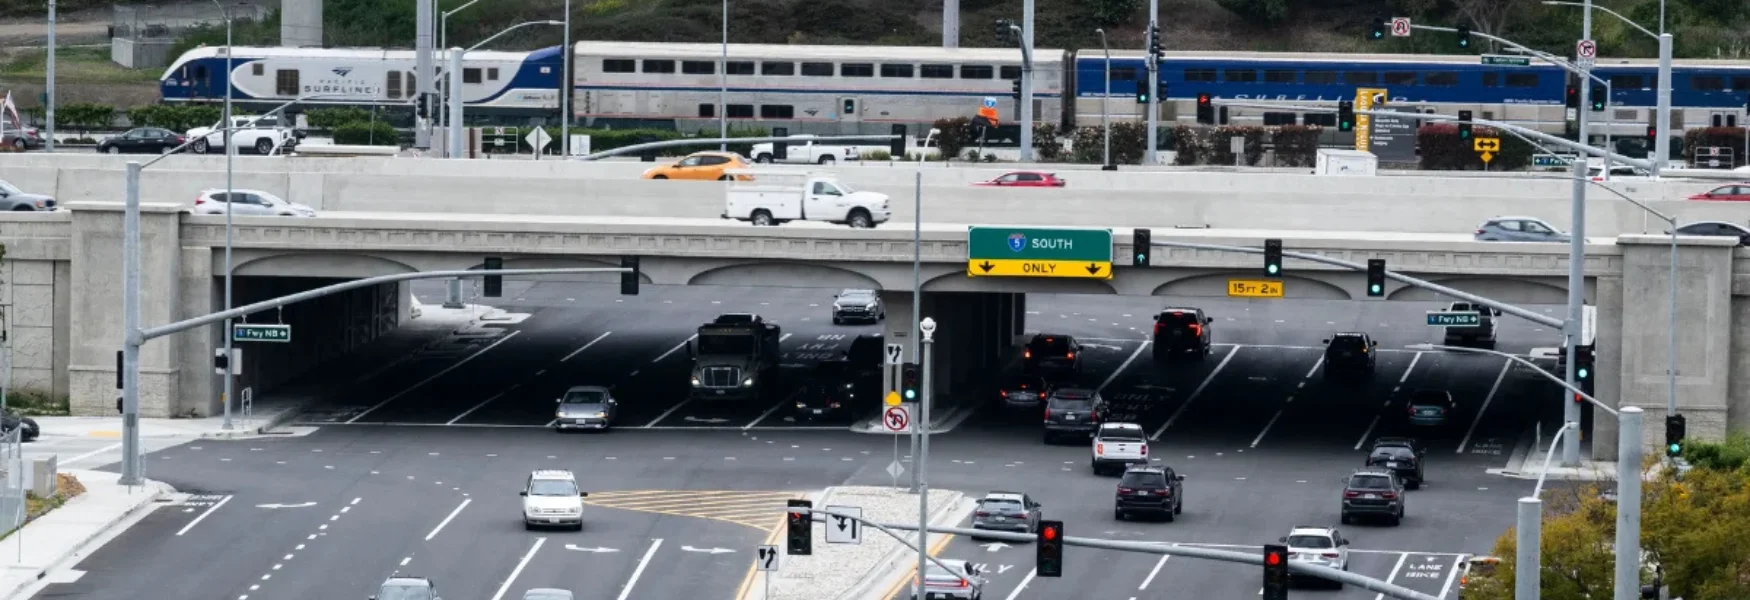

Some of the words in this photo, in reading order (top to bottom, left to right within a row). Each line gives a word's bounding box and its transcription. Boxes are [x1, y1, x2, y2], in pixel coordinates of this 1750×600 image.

[1013, 238, 1020, 248] 5
[1031, 238, 1073, 249] SOUTH
[1022, 262, 1056, 273] ONLY
[1438, 315, 1454, 324] Fwy
[246, 329, 263, 339] Fwy
[264, 329, 277, 338] NB
[1409, 563, 1443, 571] LANE
